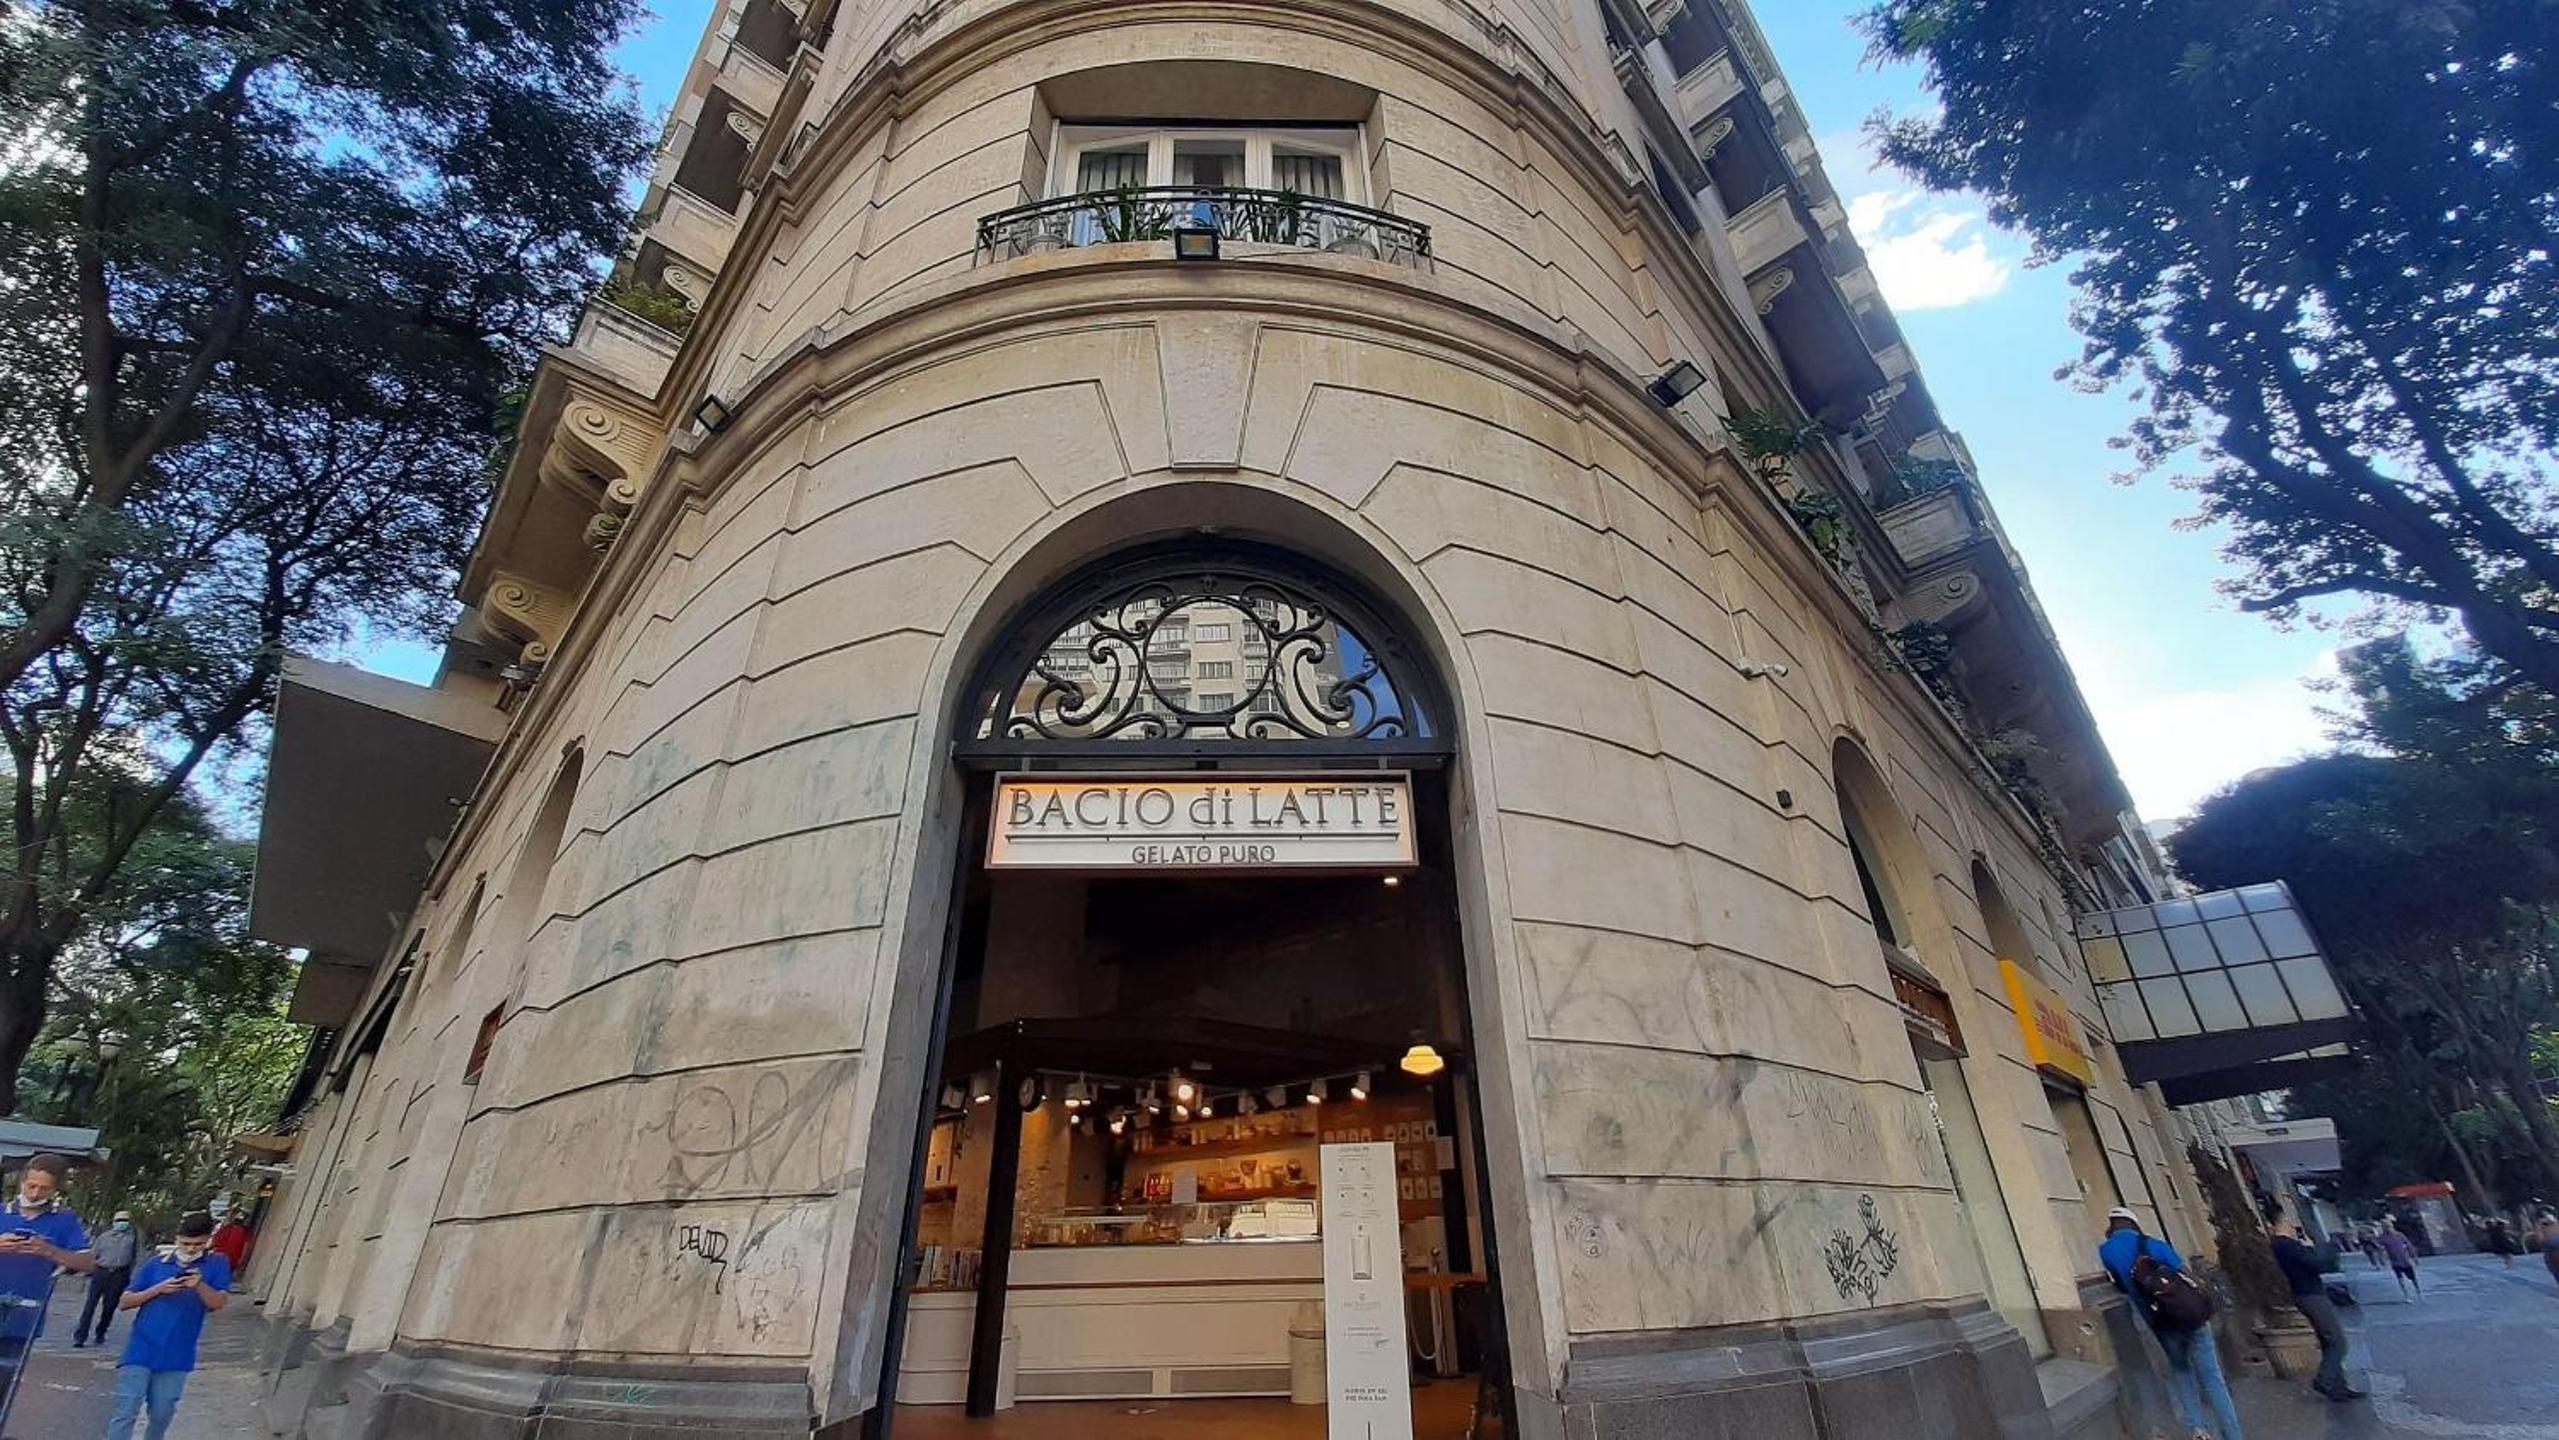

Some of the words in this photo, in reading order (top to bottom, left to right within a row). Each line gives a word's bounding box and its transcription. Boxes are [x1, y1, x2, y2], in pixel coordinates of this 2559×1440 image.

[1007, 788, 1175, 826] BACIO
[1189, 788, 1235, 826] di
[1249, 787, 1398, 826] LATTE
[1132, 846, 1212, 864] GELATO
[1219, 845, 1275, 864] PURO
